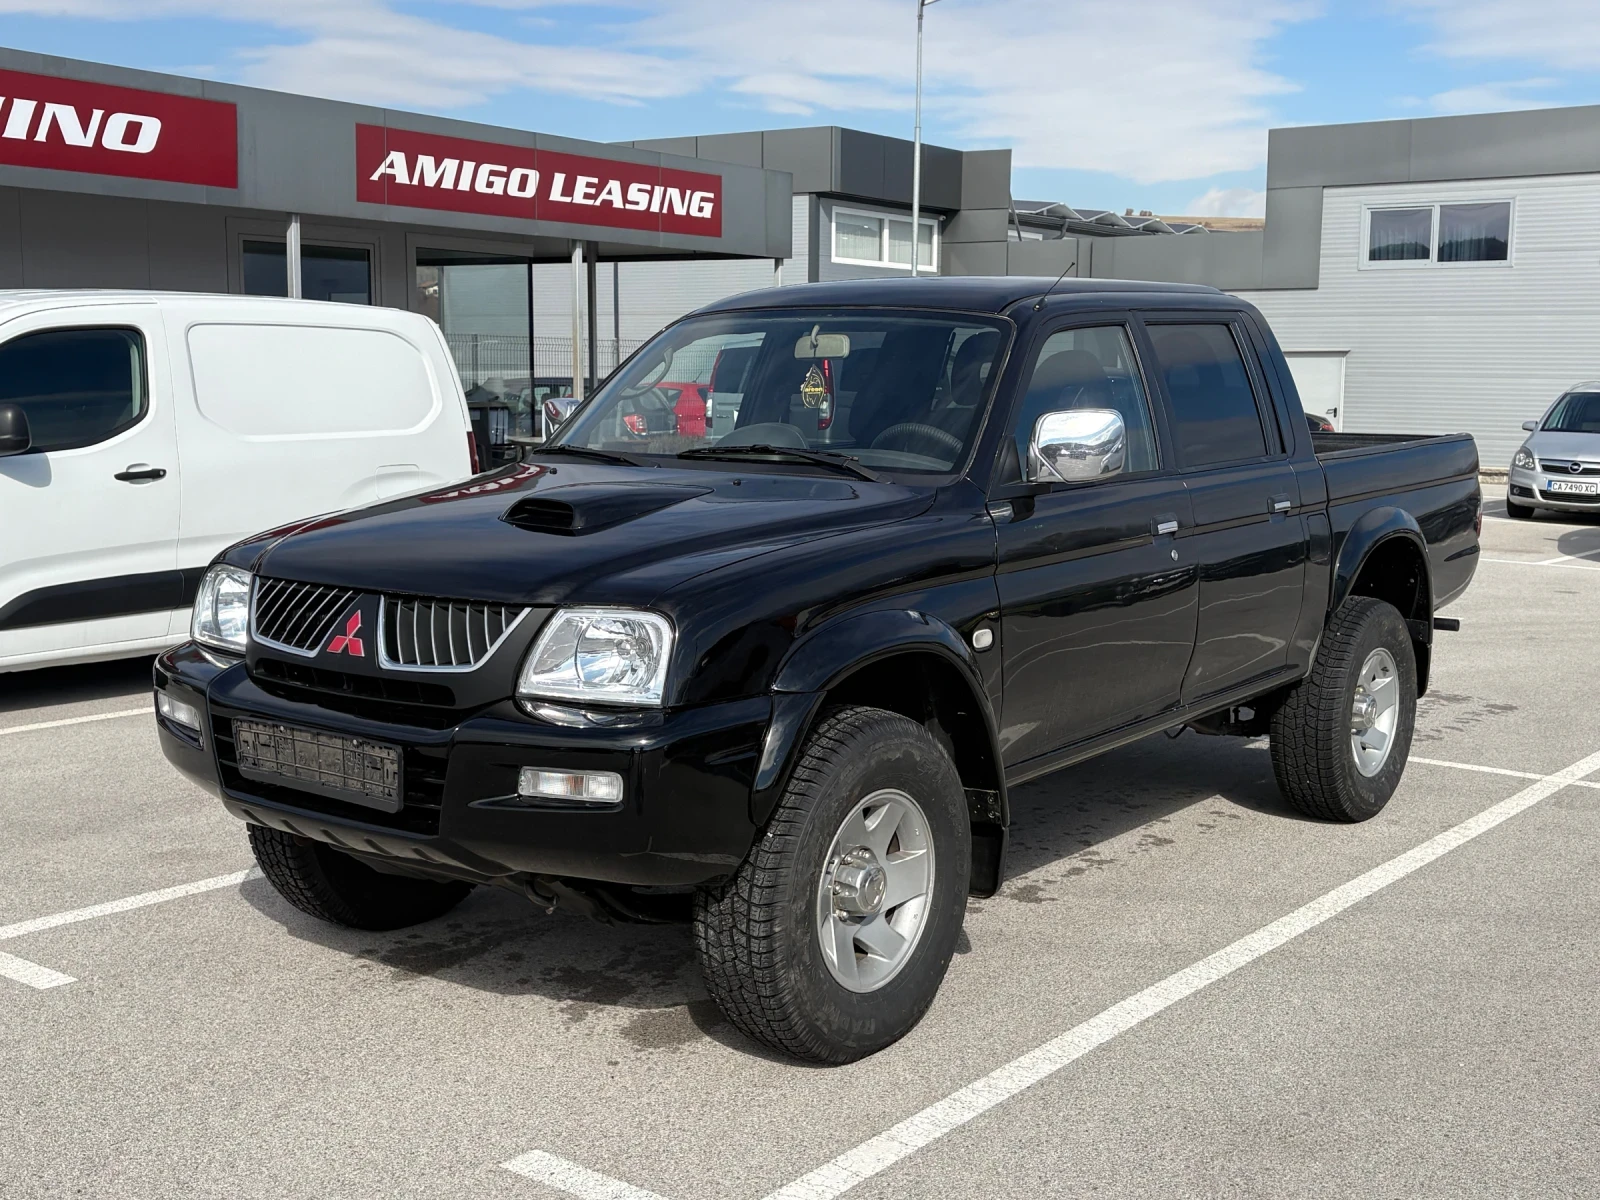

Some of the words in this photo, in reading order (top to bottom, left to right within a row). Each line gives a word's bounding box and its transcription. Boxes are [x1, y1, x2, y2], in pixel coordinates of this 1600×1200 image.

[0, 96, 162, 154] INO
[369, 150, 540, 198] AMIGO
[548, 171, 715, 219] LEASING
